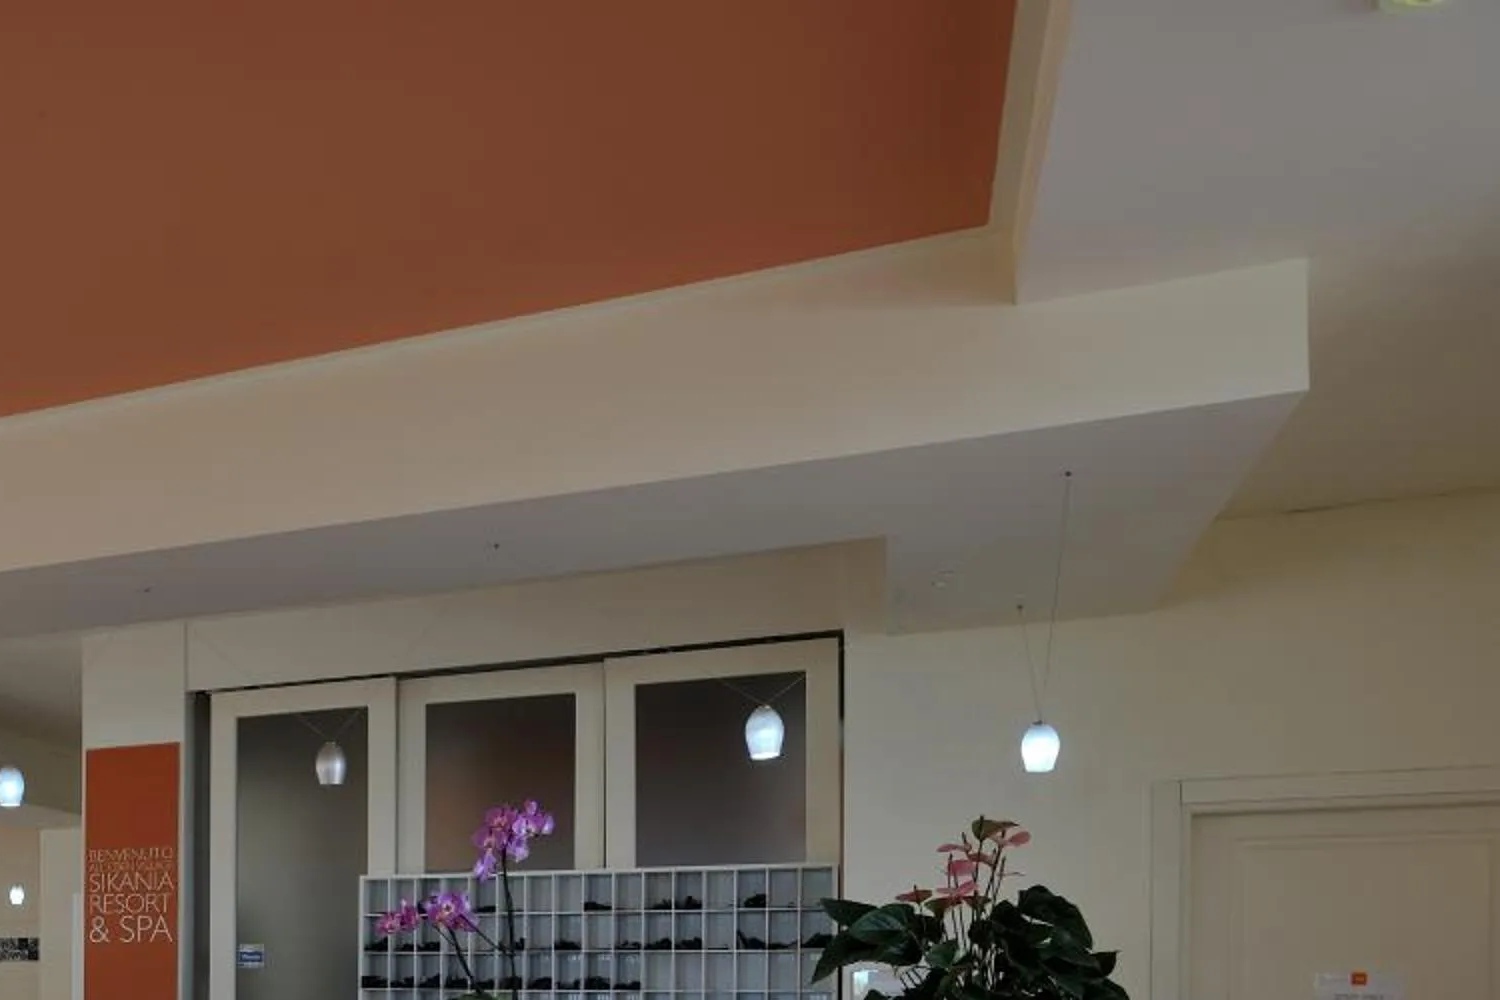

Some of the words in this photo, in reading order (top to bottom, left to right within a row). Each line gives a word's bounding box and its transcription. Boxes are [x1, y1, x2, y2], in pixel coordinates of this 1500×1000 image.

[89, 872, 175, 893] SIKANIA
[89, 893, 171, 914] RESORT
[89, 915, 109, 943] &
[120, 914, 173, 943] SPA
